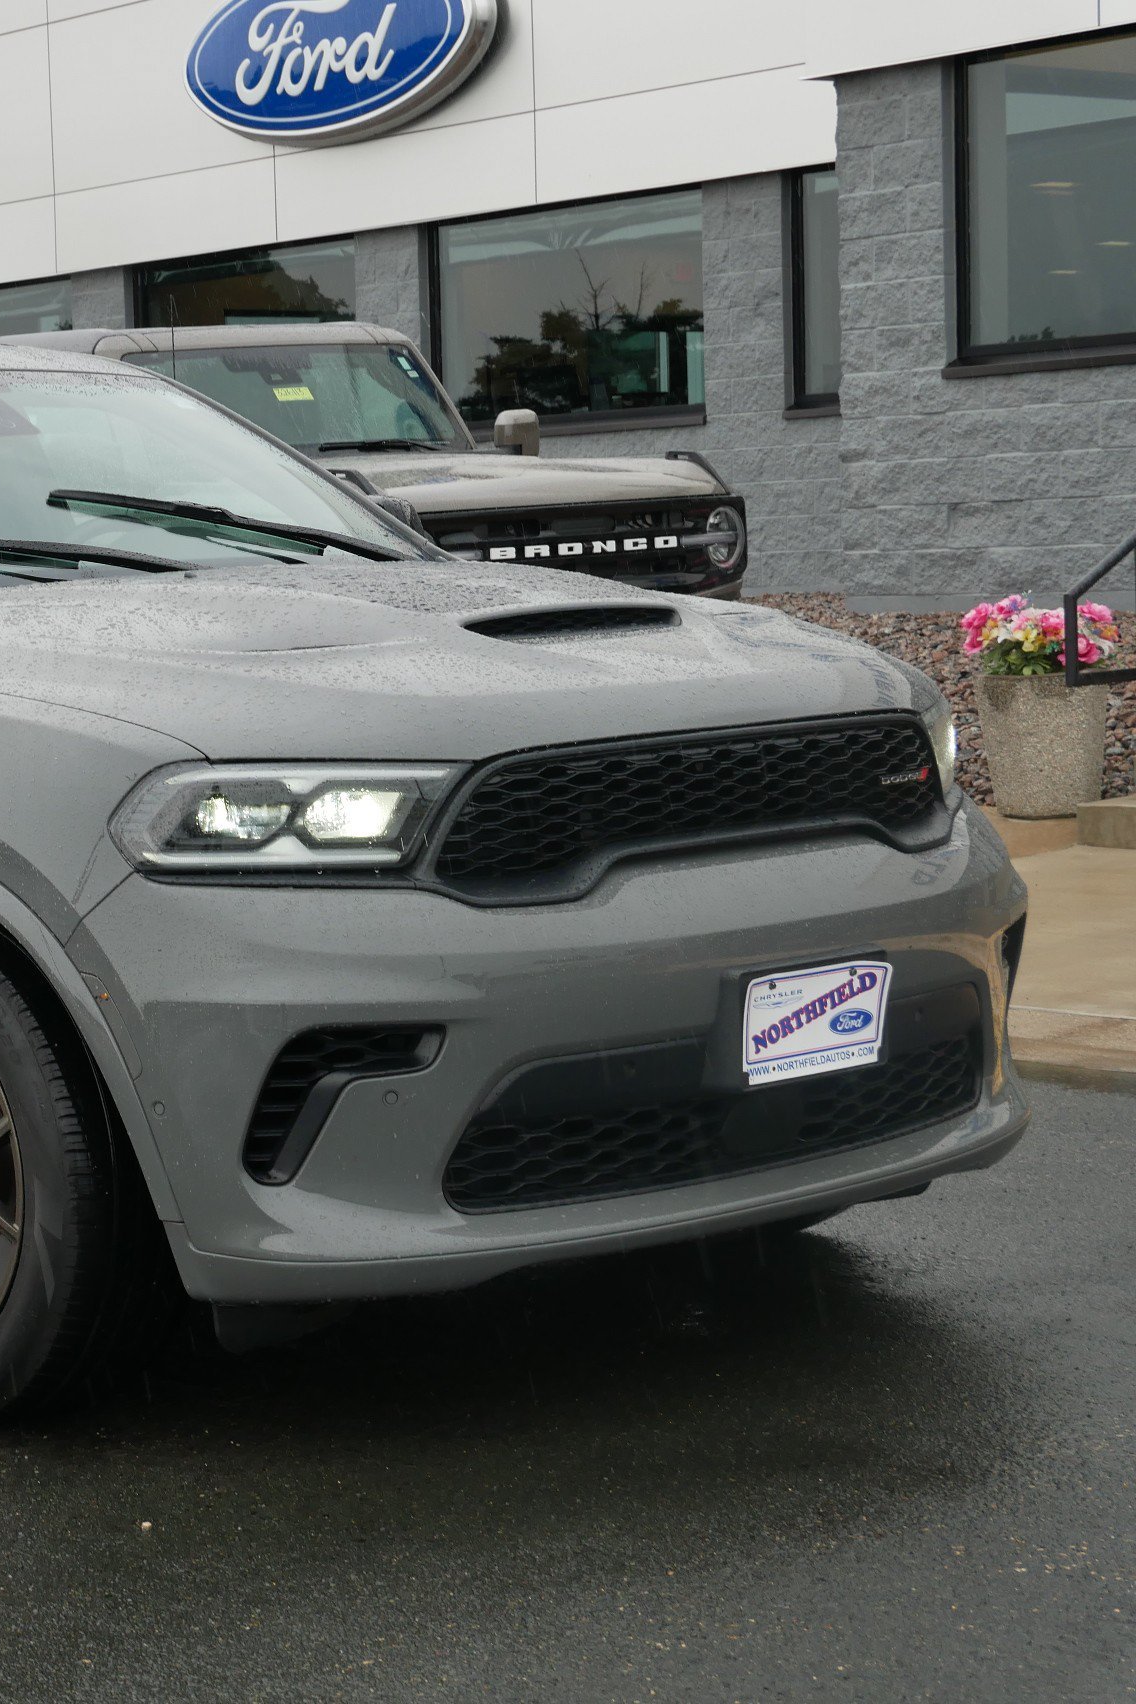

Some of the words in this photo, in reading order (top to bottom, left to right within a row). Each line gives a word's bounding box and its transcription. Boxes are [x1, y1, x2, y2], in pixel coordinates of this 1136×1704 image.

[235, 0, 398, 106] Ford
[489, 535, 678, 560] BRONCO
[753, 989, 803, 1003] CHRYSLER
[751, 971, 878, 1055] NORTHFIELD
[836, 1012, 864, 1031] Ford
